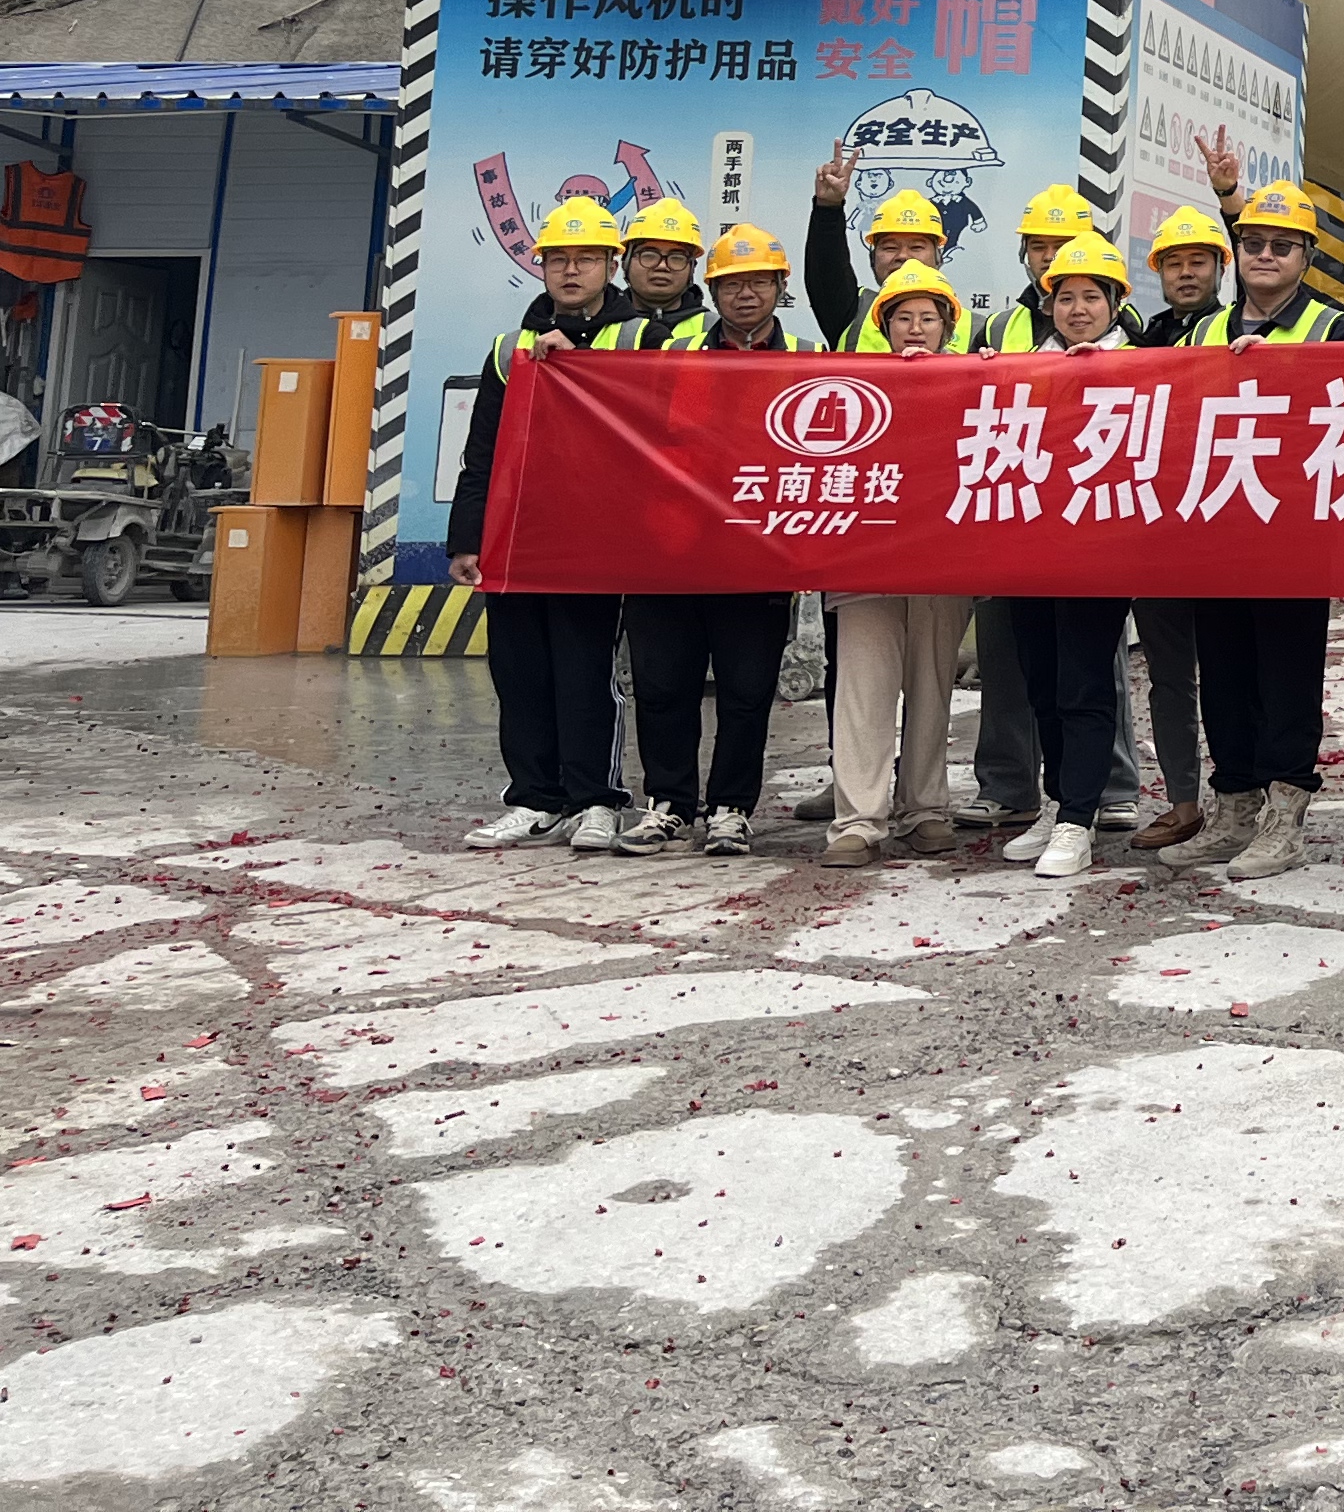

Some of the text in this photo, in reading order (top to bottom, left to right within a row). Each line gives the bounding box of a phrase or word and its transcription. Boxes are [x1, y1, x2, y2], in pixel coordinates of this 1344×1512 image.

[480, 36, 798, 81] 请穿好防护用品
[815, 37, 916, 80] 安全
[853, 117, 981, 147] 安全生产
[480, 168, 532, 257] 事故频率
[731, 463, 905, 505] 云南建投
[760, 511, 858, 536] YCIH
